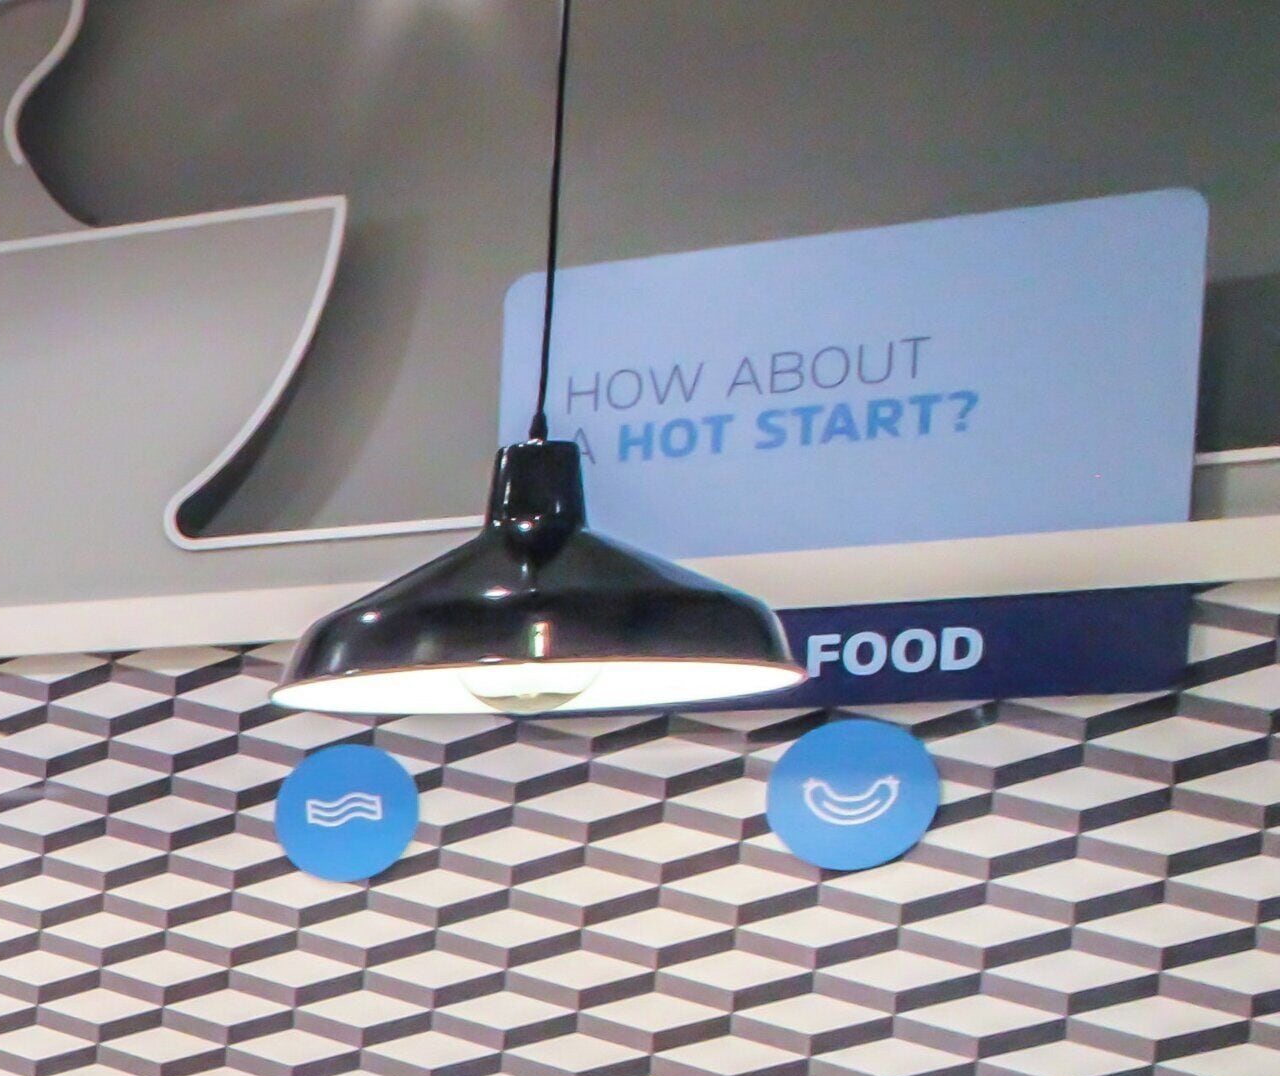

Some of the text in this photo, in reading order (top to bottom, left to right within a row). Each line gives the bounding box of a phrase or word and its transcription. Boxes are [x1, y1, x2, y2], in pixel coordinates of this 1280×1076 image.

[567, 336, 932, 414] HOW ABOUT
[618, 414, 734, 462] HOT
[755, 391, 979, 450] START?
[806, 626, 984, 678] FOOD
